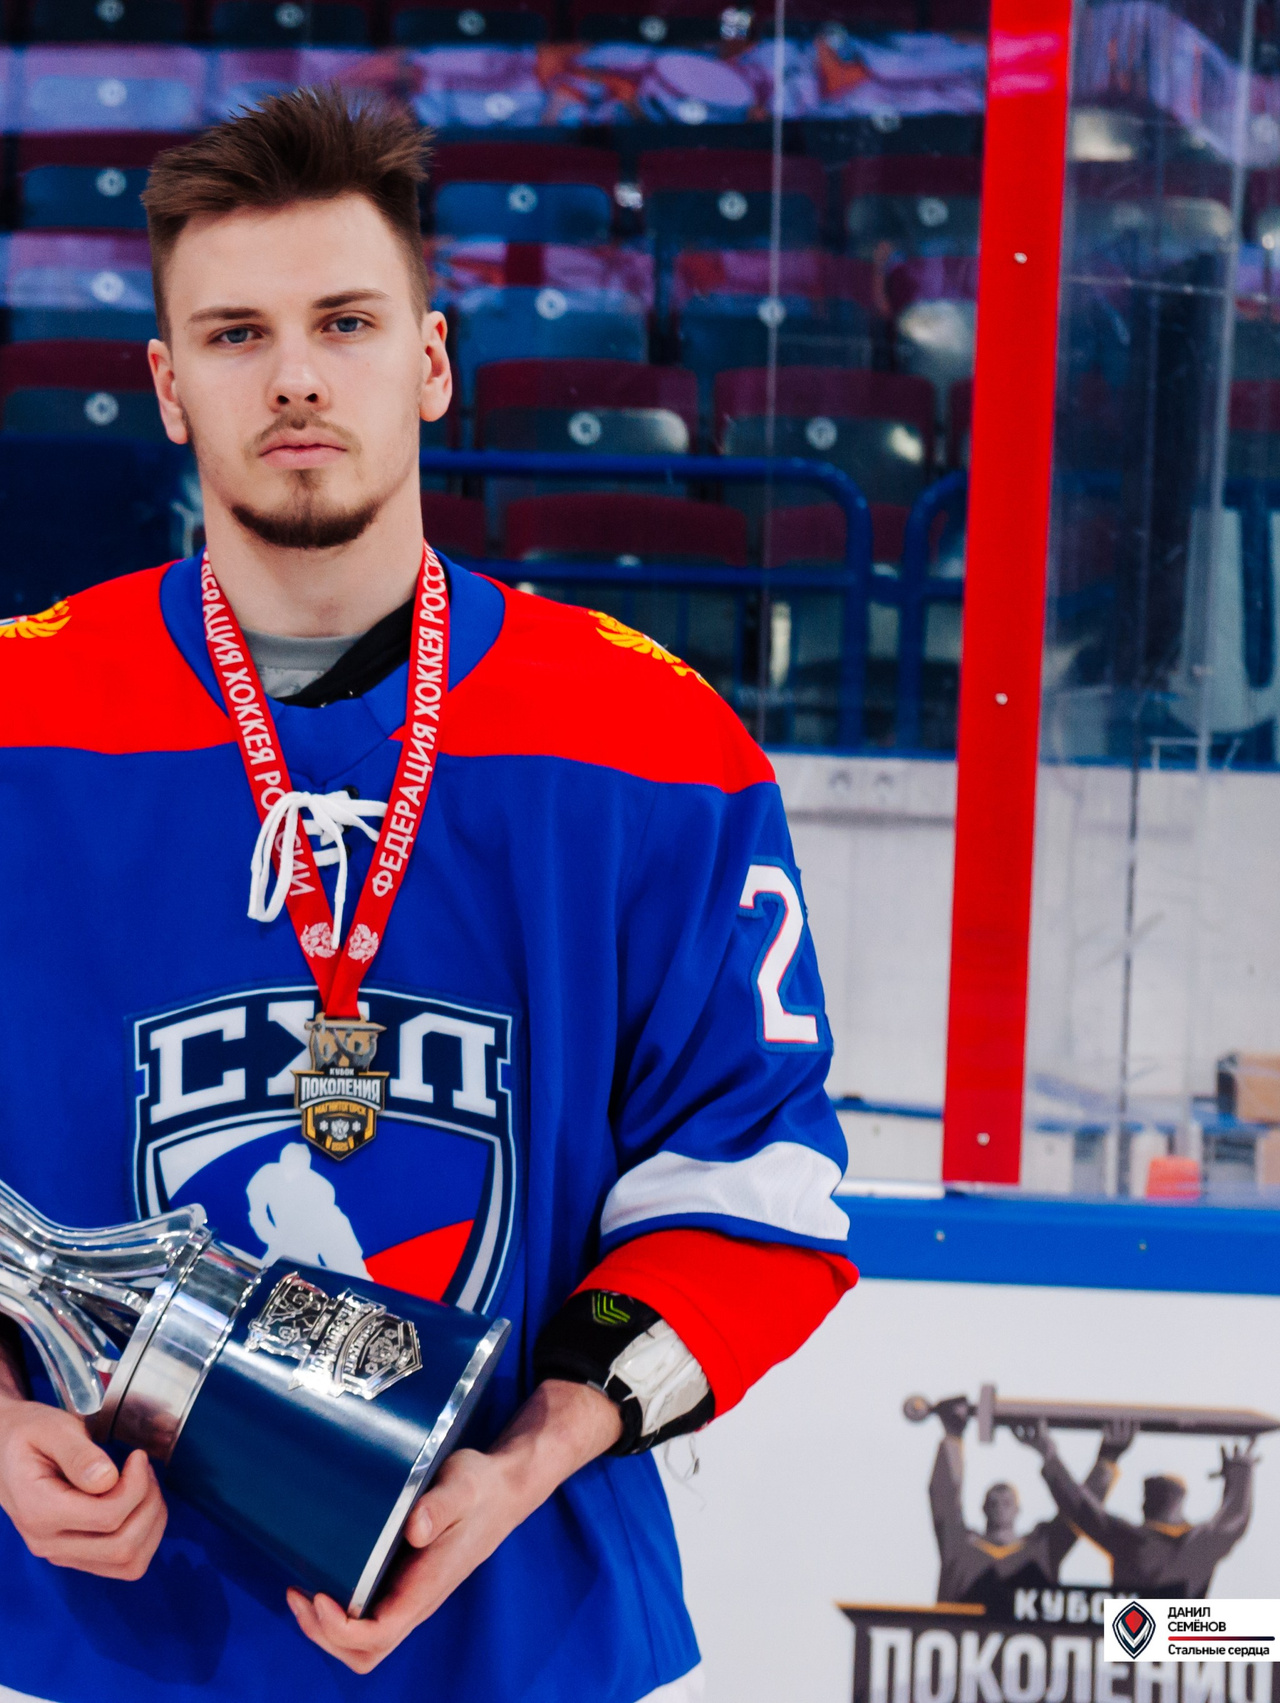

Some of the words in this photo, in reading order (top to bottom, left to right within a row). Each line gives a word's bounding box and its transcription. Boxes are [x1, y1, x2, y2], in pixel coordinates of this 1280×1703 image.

[201, 551, 245, 667] ДЕРАЦИЯ
[222, 667, 277, 766] ХОККЕЯ
[372, 721, 438, 898] ФЕДЕРАЦИЯ
[412, 625, 444, 721] ХОККЕЯ
[253, 770, 317, 898] РОСИИ
[738, 863, 819, 1044] 2
[301, 1077, 381, 1104] ПОКОЛЕНИЯ
[1013, 1588, 1140, 1624] КУБО
